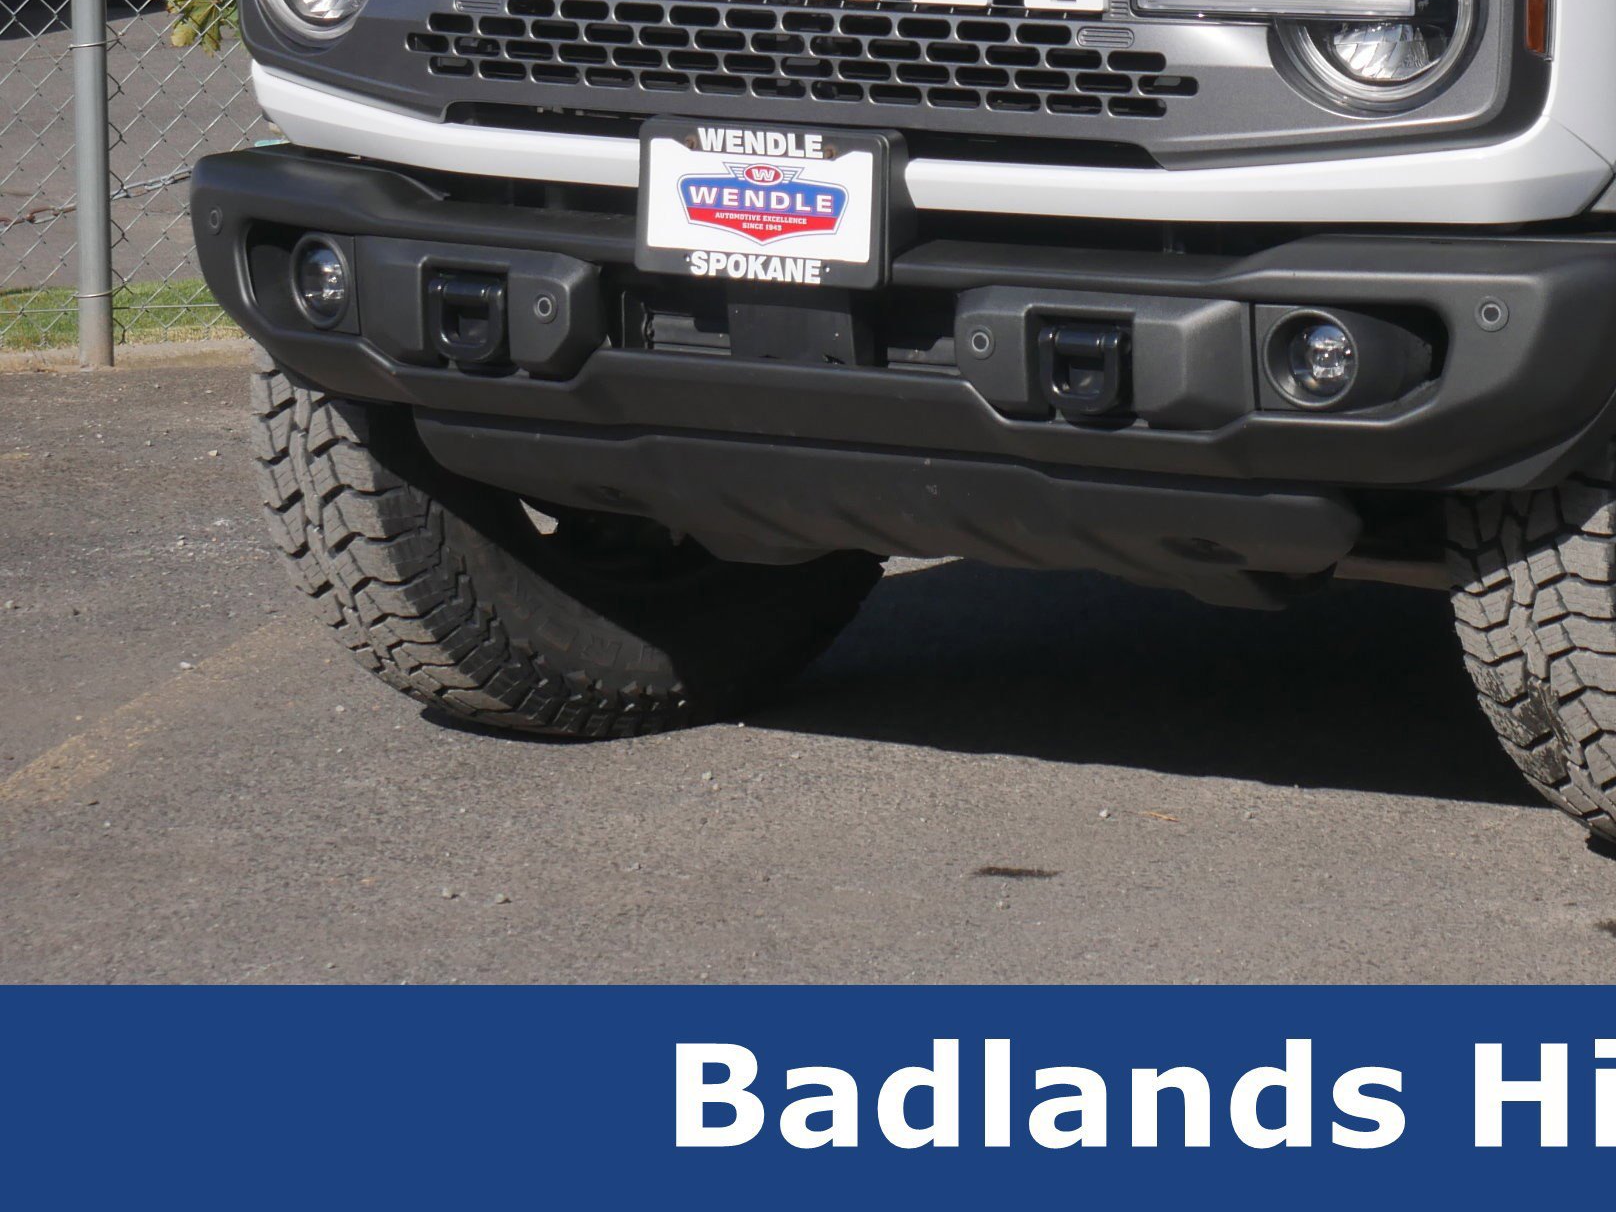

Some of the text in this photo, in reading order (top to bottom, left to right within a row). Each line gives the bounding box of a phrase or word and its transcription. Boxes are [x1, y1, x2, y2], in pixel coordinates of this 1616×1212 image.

[697, 127, 824, 159] WENDLE
[751, 167, 776, 182] W
[689, 185, 833, 213] WENDLE
[714, 212, 808, 225] AUTOMOTIVE EXCELLENCE
[742, 222, 764, 230] SINCE
[690, 251, 823, 284] SPOKANE
